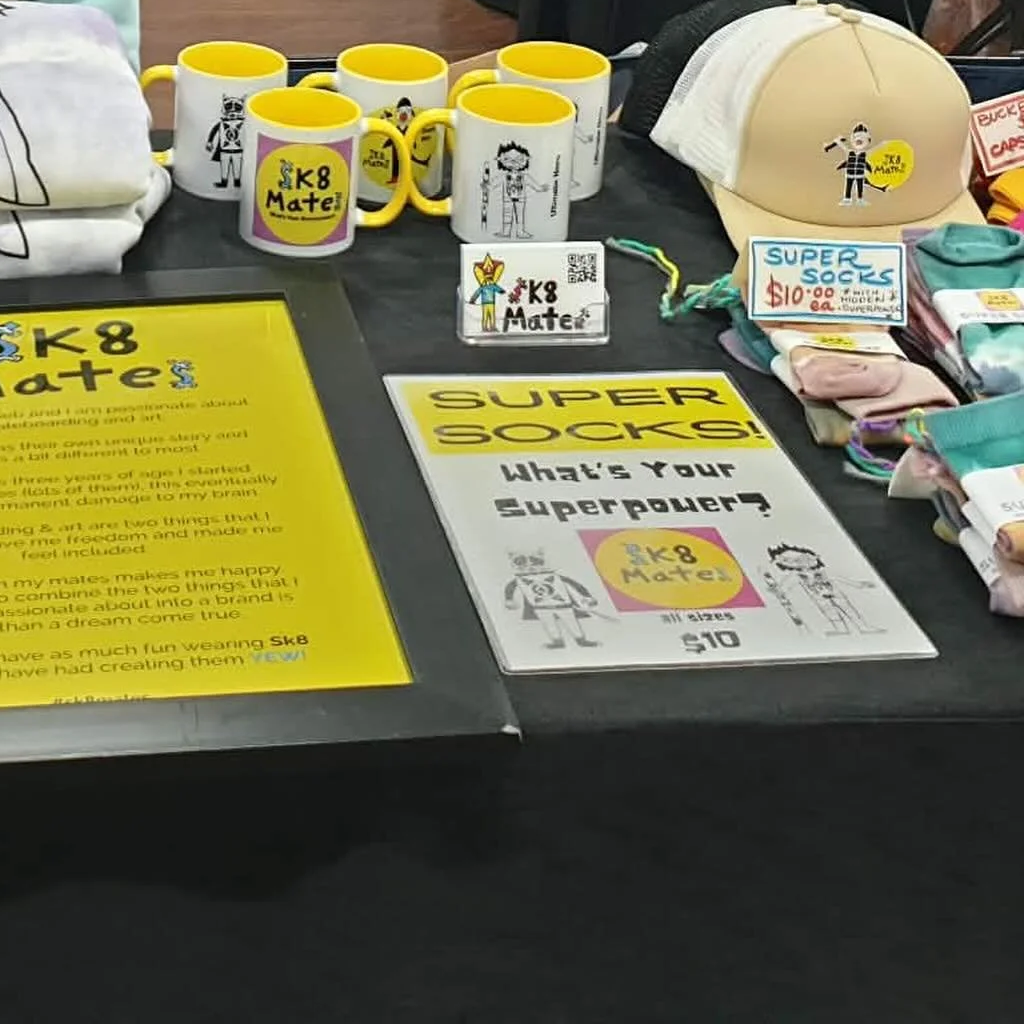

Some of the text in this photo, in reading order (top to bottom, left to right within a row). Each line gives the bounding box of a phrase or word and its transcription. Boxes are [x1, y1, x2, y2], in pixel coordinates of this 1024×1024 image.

[278, 158, 331, 191] SK8
[765, 247, 873, 270] SUPER
[801, 267, 895, 285] SOCKS
[508, 276, 558, 306] SK8
[840, 295, 885, 304] HIDDEN
[809, 300, 835, 312] ea
[502, 307, 591, 334] Mates
[428, 386, 729, 410] SUPER
[432, 419, 767, 445] SOCKS!
[13, 477, 59, 485] three
[65, 474, 112, 484] years
[118, 470, 133, 480] of
[140, 470, 173, 479] age
[189, 465, 251, 475] started
[500, 460, 738, 483] What's Your
[65, 485, 82, 494] of
[149, 480, 180, 489] this
[185, 475, 277, 486] eventually
[76, 496, 151, 505] damage
[157, 493, 174, 501] to
[179, 492, 207, 501] my
[494, 491, 772, 523] Superpower?
[40, 524, 53, 532] &
[124, 520, 158, 529] two
[163, 516, 220, 526] things
[225, 512, 261, 523] that
[30, 538, 61, 546] me
[67, 533, 147, 544] freedom
[153, 530, 188, 539] and
[194, 527, 247, 537] made
[22, 550, 57, 560] feel
[621, 542, 698, 566] SK8
[13, 579, 43, 589] my
[49, 576, 110, 585] mates
[116, 571, 179, 582] makes
[620, 566, 733, 584] Mates
[15, 590, 101, 602] combine
[107, 587, 138, 596] the
[144, 585, 180, 595] two
[186, 582, 245, 592] things
[251, 578, 288, 588] that
[93, 599, 150, 611] about
[157, 598, 193, 608] into
[215, 593, 273, 605] brand
[0, 622, 43, 632] than
[66, 617, 131, 628] dream
[138, 613, 194, 623] come
[660, 611, 736, 625] all sizes
[50, 650, 73, 659] as
[79, 645, 137, 657] much
[144, 643, 176, 654] fun
[182, 640, 264, 651] wearing
[270, 634, 309, 646] Sk8
[680, 629, 741, 655] $10
[55, 663, 93, 675] had
[100, 659, 184, 672] creating
[190, 656, 244, 667] them
